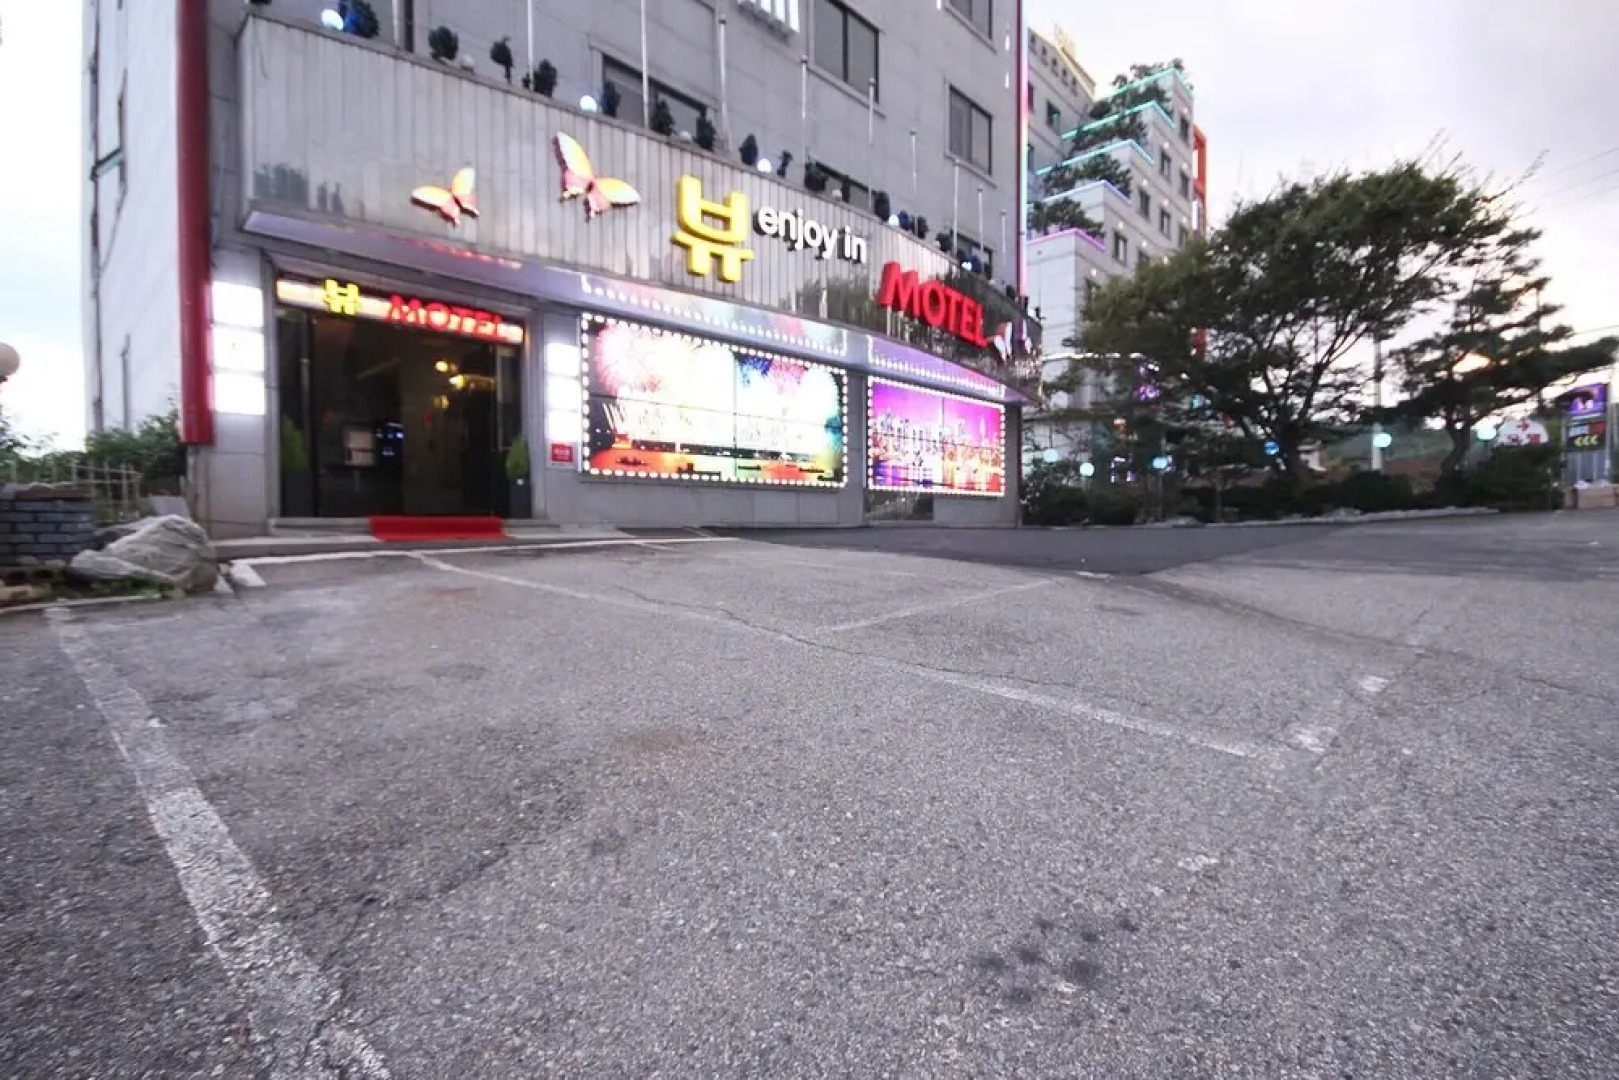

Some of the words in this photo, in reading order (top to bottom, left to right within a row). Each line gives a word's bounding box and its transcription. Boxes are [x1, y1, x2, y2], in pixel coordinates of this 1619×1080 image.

[672, 175, 754, 282] 뷰
[758, 205, 838, 258] enjoy
[843, 227, 866, 263] in
[387, 293, 508, 342] MOTEL
[879, 262, 988, 346] MOTEL
